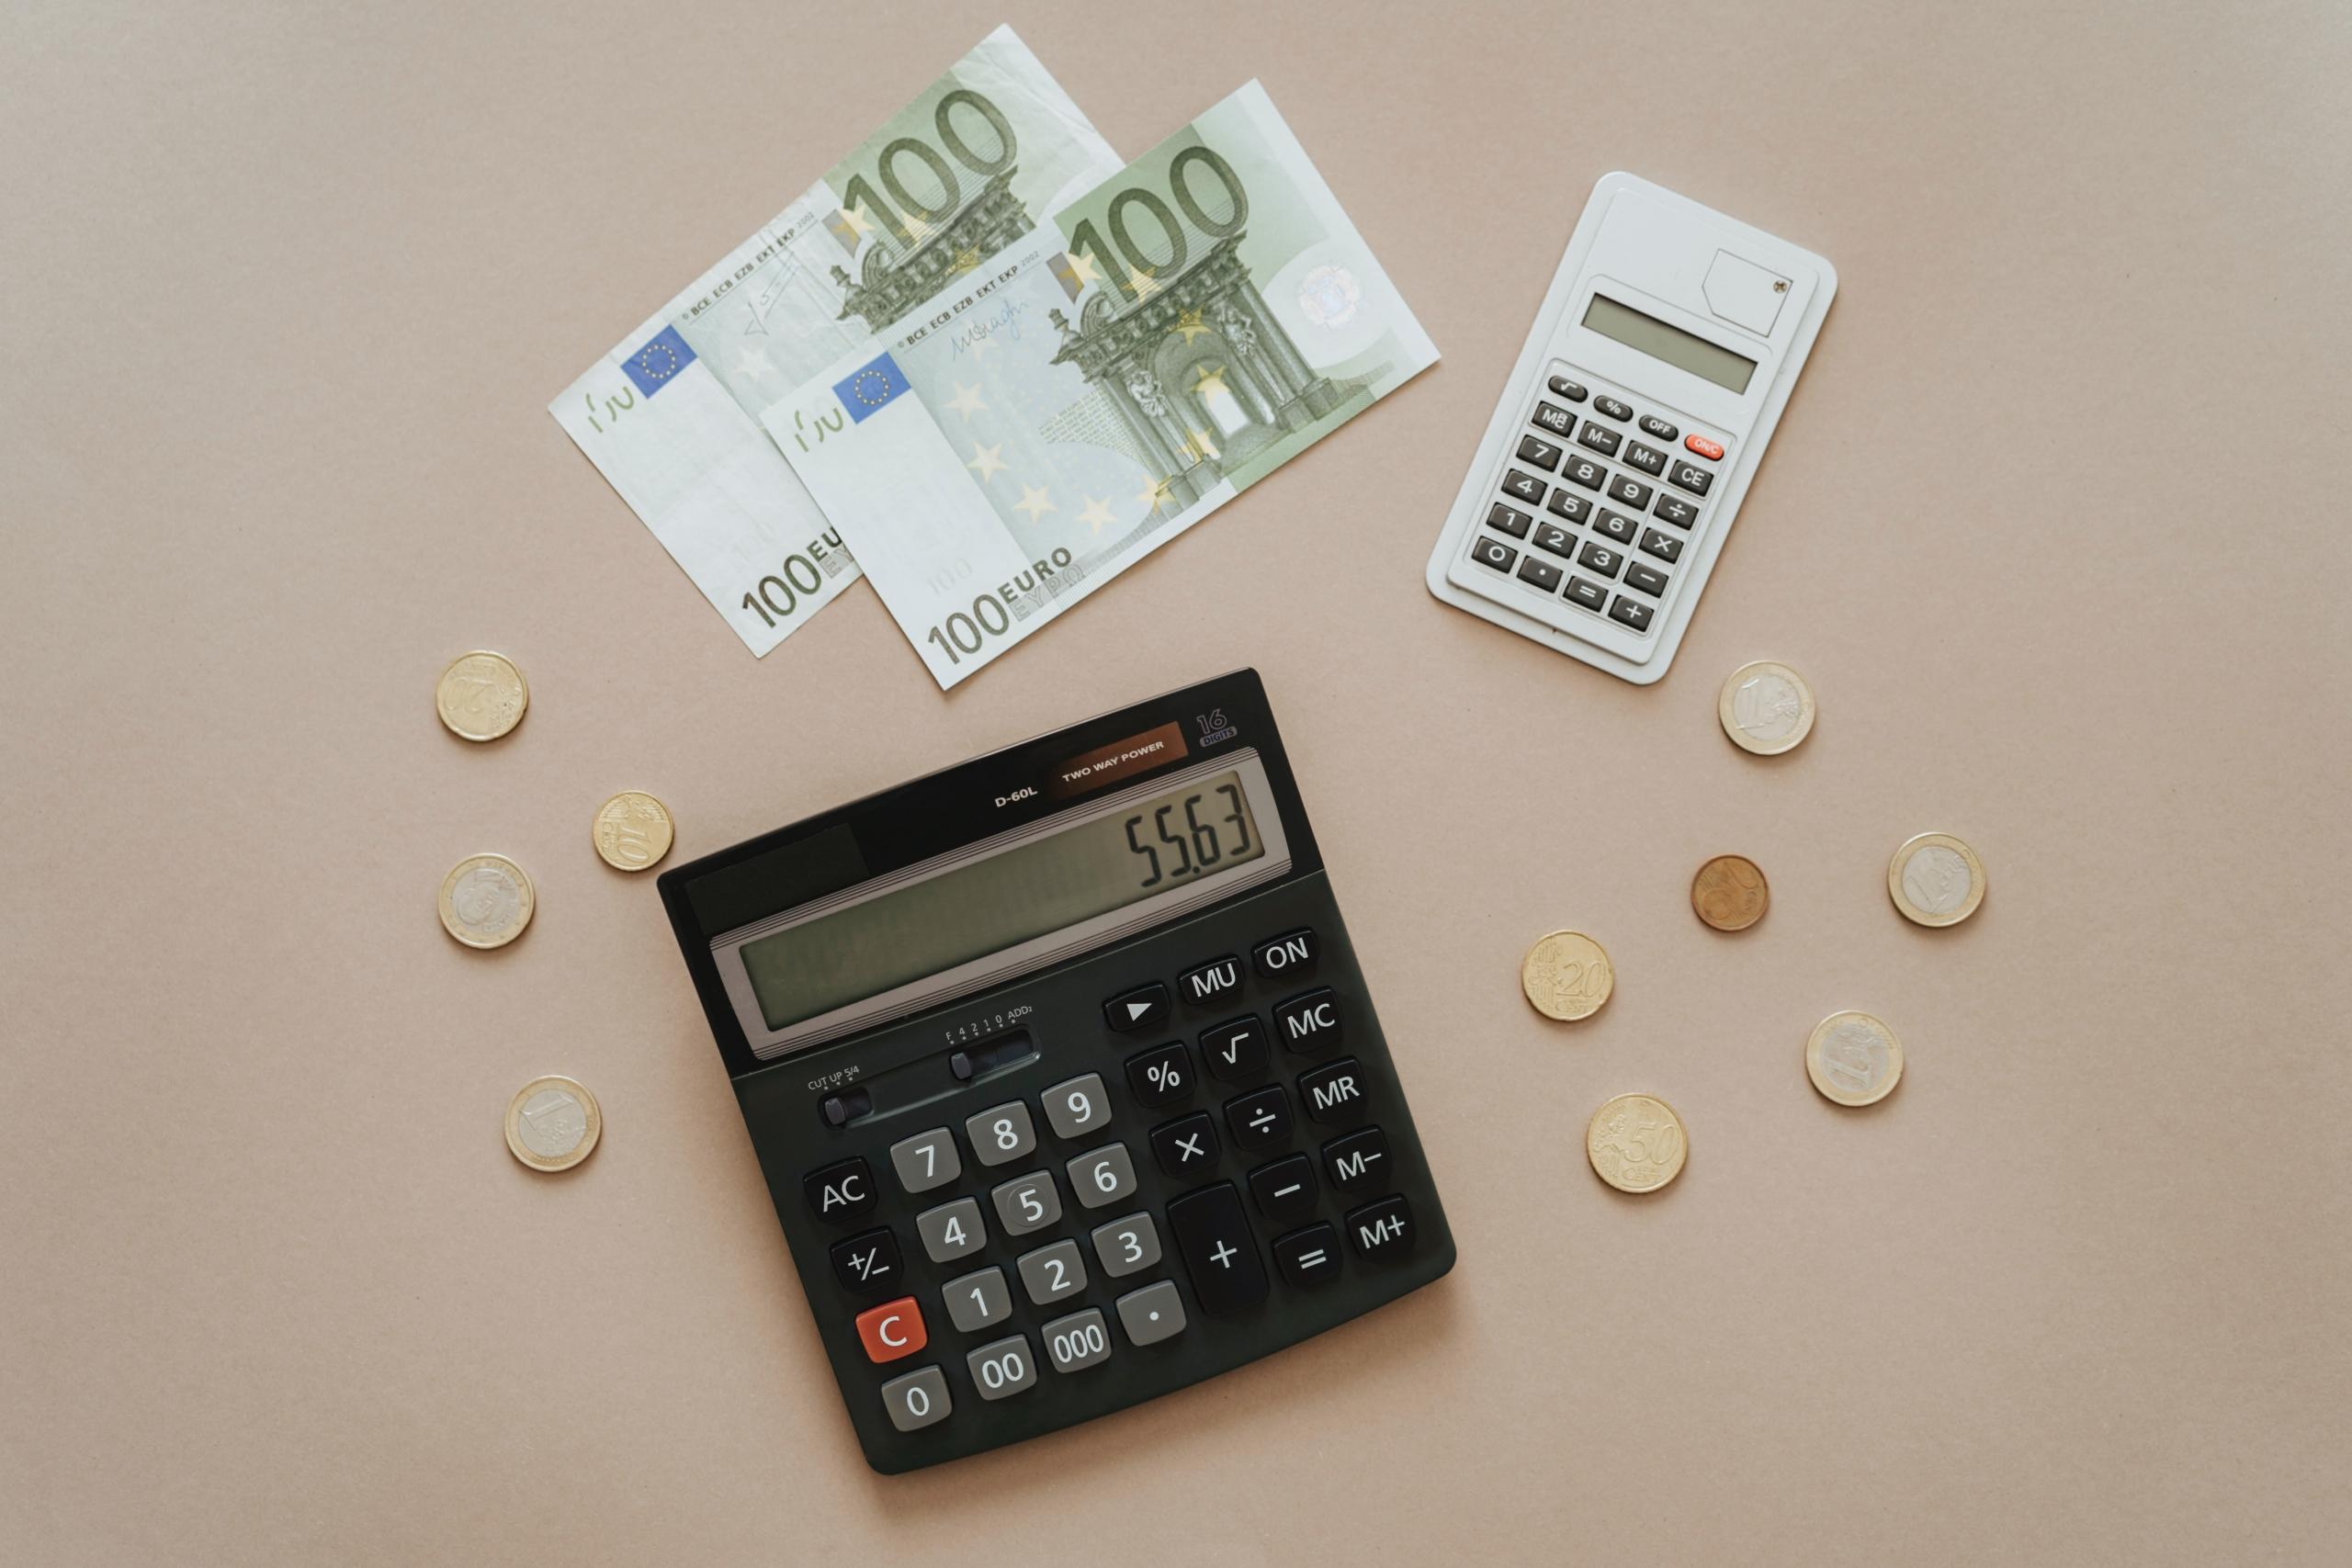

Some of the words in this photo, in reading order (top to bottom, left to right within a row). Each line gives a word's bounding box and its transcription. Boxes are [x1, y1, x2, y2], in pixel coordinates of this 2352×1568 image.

[843, 89, 1017, 250] 100
[1069, 146, 1249, 303] 100
[690, 297, 712, 316] BCE
[712, 279, 733, 299] ECB
[734, 263, 754, 280] EZB
[755, 245, 776, 264] EKT
[776, 228, 796, 247] EKP
[906, 327, 928, 345] BCE
[930, 311, 952, 330] ECB
[953, 296, 974, 314] EZB
[976, 281, 997, 299] EKT
[999, 265, 1019, 284] EKP
[1649, 420, 1671, 434] OFF
[1534, 444, 1550, 458] 7
[1634, 448, 1657, 466] M+
[1694, 438, 1719, 456] ON/C
[1517, 479, 1532, 494] 4
[1577, 464, 1595, 480] 8
[1681, 468, 1704, 486] CE
[1563, 497, 1580, 513] 5
[1623, 484, 1639, 499] 9
[1507, 513, 1515, 526] 1
[1609, 517, 1624, 533] 6
[1488, 546, 1506, 562] 0
[1547, 531, 1565, 547] 2
[1593, 550, 1611, 567] 3
[742, 554, 821, 628] 100
[928, 594, 1010, 665] 100
[997, 547, 1071, 604] EURO
[1196, 707, 1227, 735] 16
[1203, 727, 1236, 745] DIGITS
[1062, 766, 1091, 783] TWO
[1093, 757, 1118, 772] WAY
[1120, 740, 1165, 762] POWER
[994, 786, 1038, 808] D-60L
[1125, 784, 1250, 888] 55.63
[1265, 937, 1308, 969] ON
[1192, 963, 1237, 998] MU
[1555, 962, 1606, 998] 20
[945, 1032, 952, 1040] F
[959, 1027, 966, 1035] 4
[970, 1022, 978, 1032] 2
[983, 1019, 989, 1027] 1
[995, 1014, 1002, 1023] 0
[1287, 1003, 1336, 1039] MC
[808, 1077, 827, 1090] CUT
[829, 1071, 842, 1082] UP
[843, 1065, 860, 1077] 5/4
[1313, 1076, 1360, 1110] MR
[1067, 1091, 1091, 1123] 9
[992, 1119, 1019, 1150] 8
[1623, 1121, 1677, 1166] 50
[914, 1145, 935, 1178] 7
[1094, 1161, 1117, 1192] 6
[822, 1175, 865, 1213] AC
[1019, 1189, 1044, 1222] 5
[944, 1216, 967, 1247] 4
[1360, 1213, 1406, 1249] M+
[1118, 1231, 1143, 1263] 3
[1044, 1258, 1071, 1292] 2
[969, 1287, 989, 1316] 1
[879, 1315, 908, 1347] C
[1053, 1324, 1103, 1365] 000
[981, 1352, 1024, 1389] 00
[906, 1387, 930, 1416] 0
